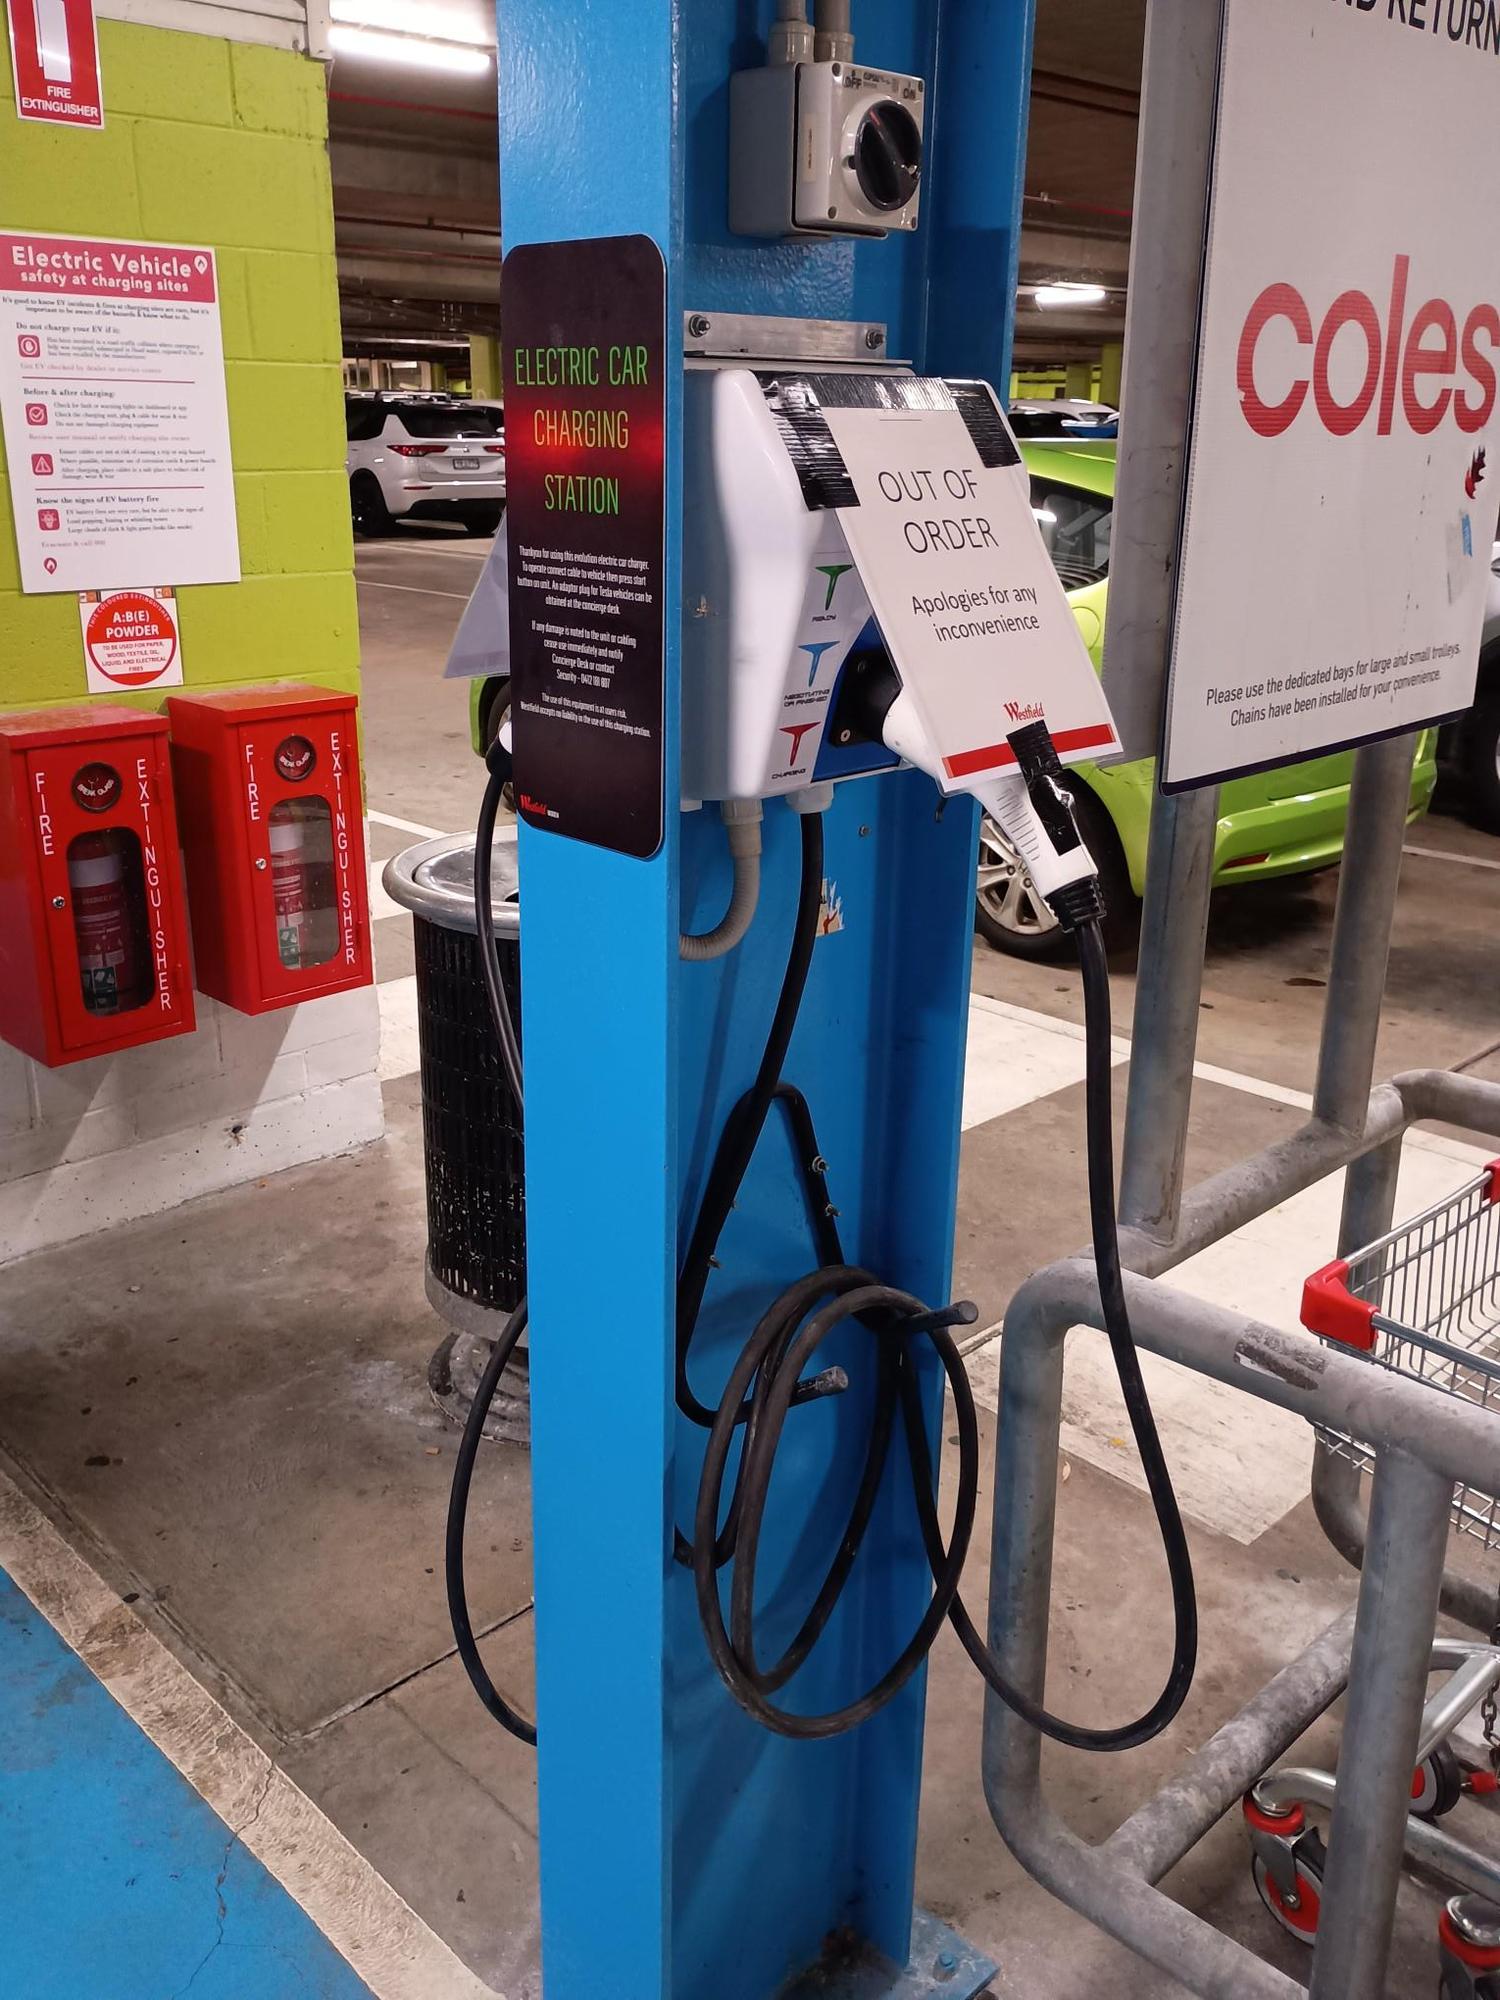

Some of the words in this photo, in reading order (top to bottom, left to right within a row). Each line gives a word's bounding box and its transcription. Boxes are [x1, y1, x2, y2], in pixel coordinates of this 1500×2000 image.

[47, 86, 72, 98] FIRE
[844, 76, 862, 89] OFF
[903, 88, 916, 99] ON
[22, 97, 98, 118] EXTINGUISHER
[12, 245, 104, 272] Electric
[111, 253, 192, 278] Vehicle
[21, 269, 66, 288] safety
[72, 274, 86, 286] at
[92, 273, 152, 292] charging
[157, 278, 189, 292] sites
[1236, 254, 1500, 437] coles
[515, 347, 599, 386] ELECTRIC
[608, 346, 648, 386] CAR
[24, 388, 48, 396] Before
[59, 388, 78, 396] after
[534, 409, 629, 449] CHARGING
[544, 474, 619, 516] STATION
[878, 471, 938, 502] OUT
[943, 469, 978, 499] OF
[36, 496, 58, 504] Know
[74, 497, 94, 506] signs
[118, 495, 144, 504] battery
[903, 518, 999, 553] ORDER
[550, 549, 563, 562] using
[564, 550, 573, 561] this
[574, 552, 597, 564] evolution
[598, 554, 618, 566] electric
[618, 558, 627, 567] car
[529, 564, 546, 574] operate
[547, 566, 566, 576] connect
[567, 567, 580, 578] cable
[581, 569, 587, 579] to
[588, 569, 605, 580] vehicle
[606, 571, 618, 582] then
[619, 574, 632, 584] press
[633, 575, 646, 586] start
[517, 576, 532, 586] button
[579, 584, 590, 596] plug
[599, 585, 612, 597] Tesla
[613, 589, 634, 600] vehicles
[635, 593, 645, 602] can
[645, 592, 652, 603] be
[912, 589, 988, 616] Apologies
[988, 584, 1010, 604] for
[1014, 584, 1038, 604] any
[112, 610, 150, 624] A:B(E)
[545, 595, 566, 607] obtained
[567, 599, 572, 608] at
[573, 598, 581, 609] the
[582, 601, 606, 614] concierge
[106, 624, 160, 638] POWDER
[546, 622, 564, 636] damage
[570, 628, 584, 638] noted
[591, 630, 600, 640] the
[932, 614, 1040, 642] inconvenience
[544, 639, 558, 648] cease
[567, 640, 597, 657] immediately
[598, 647, 607, 657] and
[552, 653, 576, 668] Concierge
[577, 657, 588, 669] Desk
[596, 663, 615, 674] contact
[1206, 688, 1243, 706] Please
[1246, 683, 1264, 698] use
[1266, 678, 1283, 694] the
[1285, 666, 1332, 690] dedicated
[1333, 666, 1354, 682] bays
[1356, 660, 1369, 676] for
[1370, 658, 1392, 674] large
[1393, 651, 1408, 668] and
[1409, 646, 1430, 664] small
[1003, 701, 1044, 722] Westfield
[1231, 706, 1266, 726] Chains
[1268, 702, 1291, 719] have
[1294, 698, 1317, 714] been
[1319, 684, 1357, 707] installed
[1360, 683, 1372, 698] for
[1373, 680, 1392, 699] your
[246, 744, 260, 820] FIRE
[36, 772, 54, 856] FIRE
[330, 732, 356, 965] EXTINGUISHER
[136, 758, 172, 1011] EXTINGUISHER
